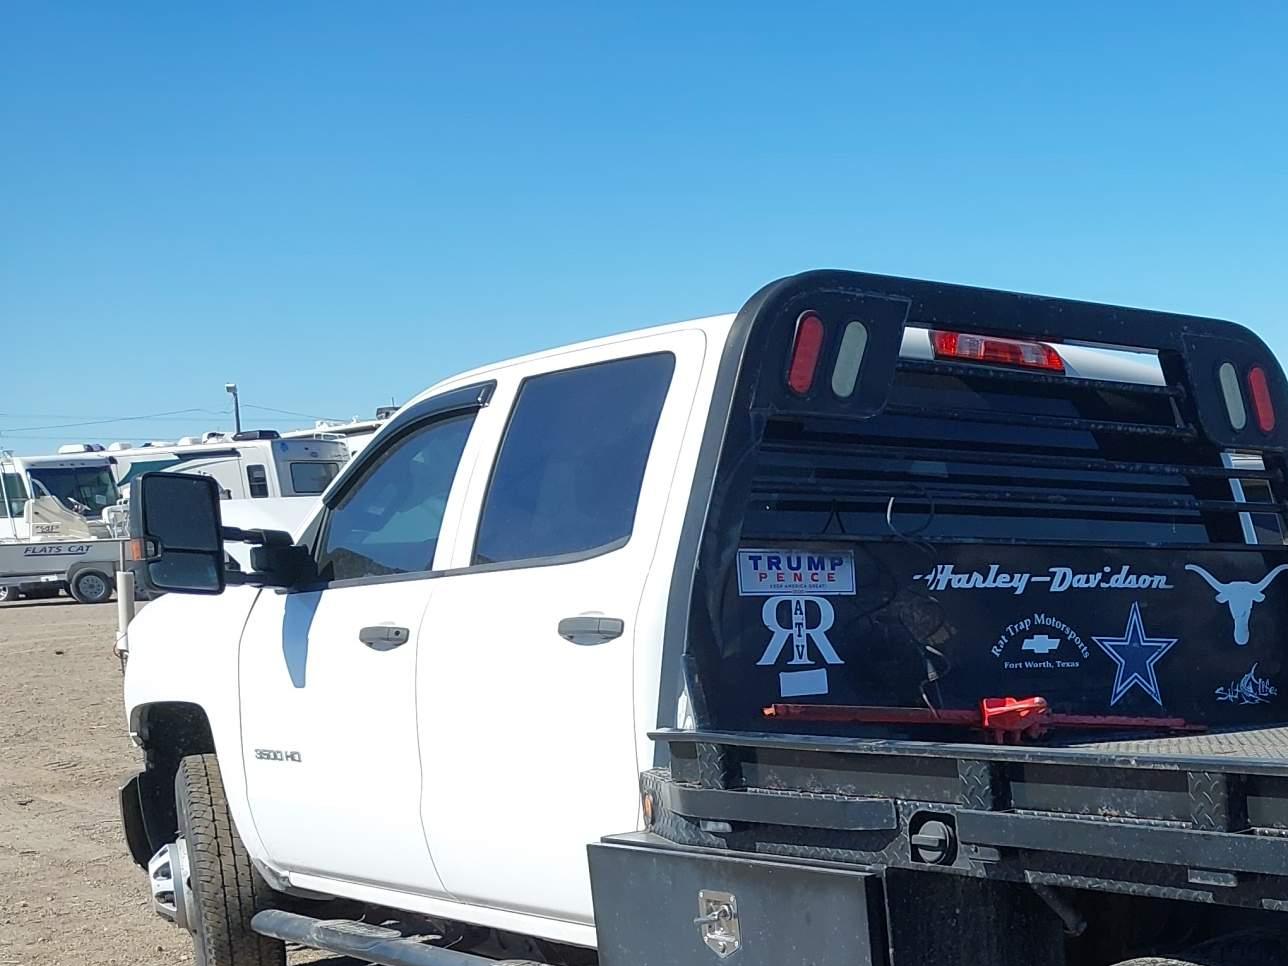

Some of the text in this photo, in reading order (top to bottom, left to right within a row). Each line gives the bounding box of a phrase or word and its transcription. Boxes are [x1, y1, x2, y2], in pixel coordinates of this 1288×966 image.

[23, 544, 93, 555] FLATS CAT
[748, 555, 844, 571] TRUMP
[759, 572, 837, 582] PENCE
[913, 564, 1174, 595] Harley-Davidson
[793, 599, 806, 661] ATV
[991, 613, 1090, 659] Rat Trap Motorsports
[1004, 661, 1023, 669] Fort
[1055, 660, 1080, 668] Texas
[254, 749, 302, 763] 3500 HD
